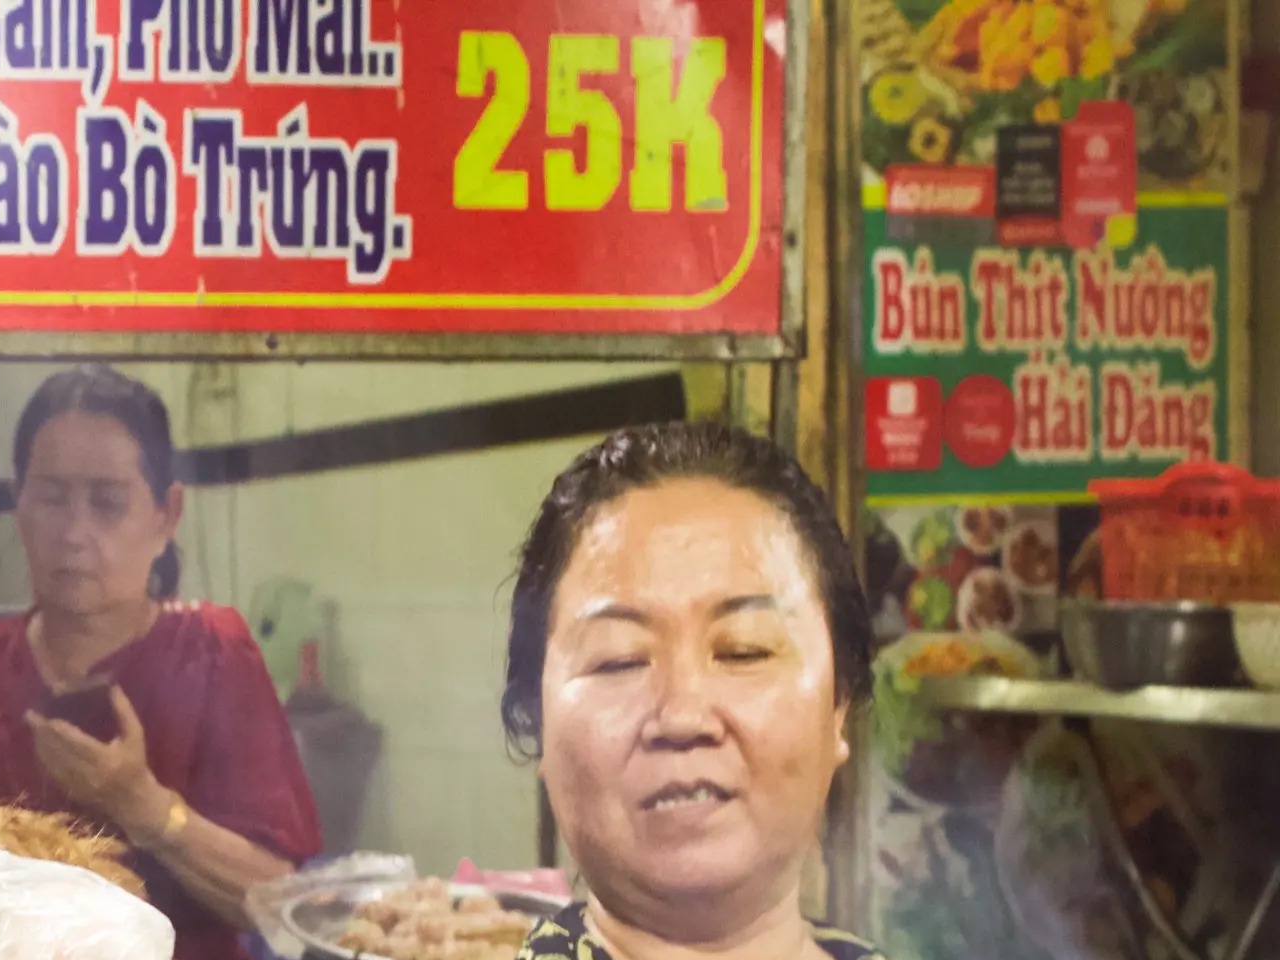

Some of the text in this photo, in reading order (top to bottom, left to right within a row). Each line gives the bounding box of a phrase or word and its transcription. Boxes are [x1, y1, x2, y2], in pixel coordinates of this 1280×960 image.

[82, 113, 170, 249] Bò
[189, 115, 406, 273] Trứng.
[453, 30, 728, 211] 25K
